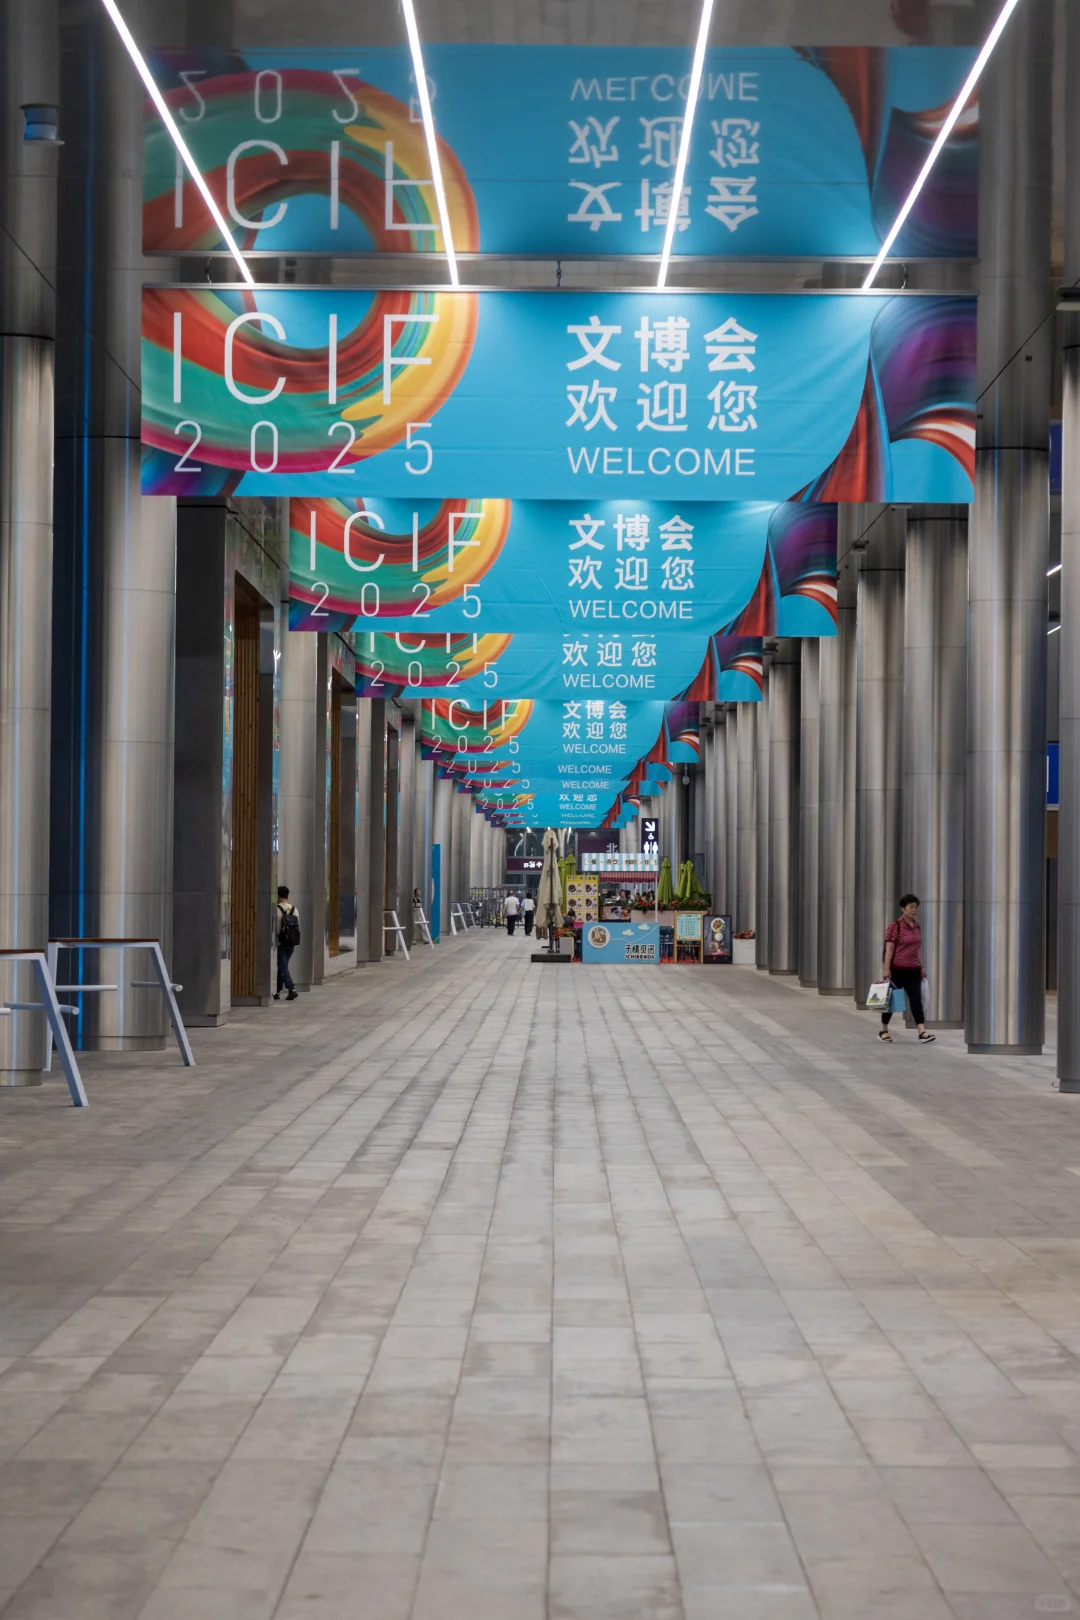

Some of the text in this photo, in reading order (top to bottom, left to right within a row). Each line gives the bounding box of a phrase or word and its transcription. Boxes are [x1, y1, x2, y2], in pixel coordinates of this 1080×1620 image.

[565, 315, 759, 373] 文博会
[173, 312, 440, 405] ICIF
[565, 379, 759, 432] 欢迎您
[173, 420, 433, 475] 2025
[566, 447, 756, 476] WELCOME
[309, 510, 486, 573] ICIF
[568, 513, 695, 552] 文博会
[568, 555, 695, 591] 欢迎您
[310, 581, 481, 619] 2025
[568, 600, 693, 619] WELCOME
[562, 641, 657, 667] 欢迎您
[370, 660, 498, 688] 2025
[562, 673, 656, 689] WELCOME
[432, 698, 521, 731] ICIF
[562, 700, 627, 720] 文博会
[562, 721, 627, 740] 欢迎您
[432, 735, 519, 754] 2025
[562, 743, 627, 754] WELCOME
[557, 764, 612, 775] WELCOME
[562, 781, 610, 790] WELCOME
[482, 798, 534, 810] 2025
[559, 803, 597, 811] WELCOME
